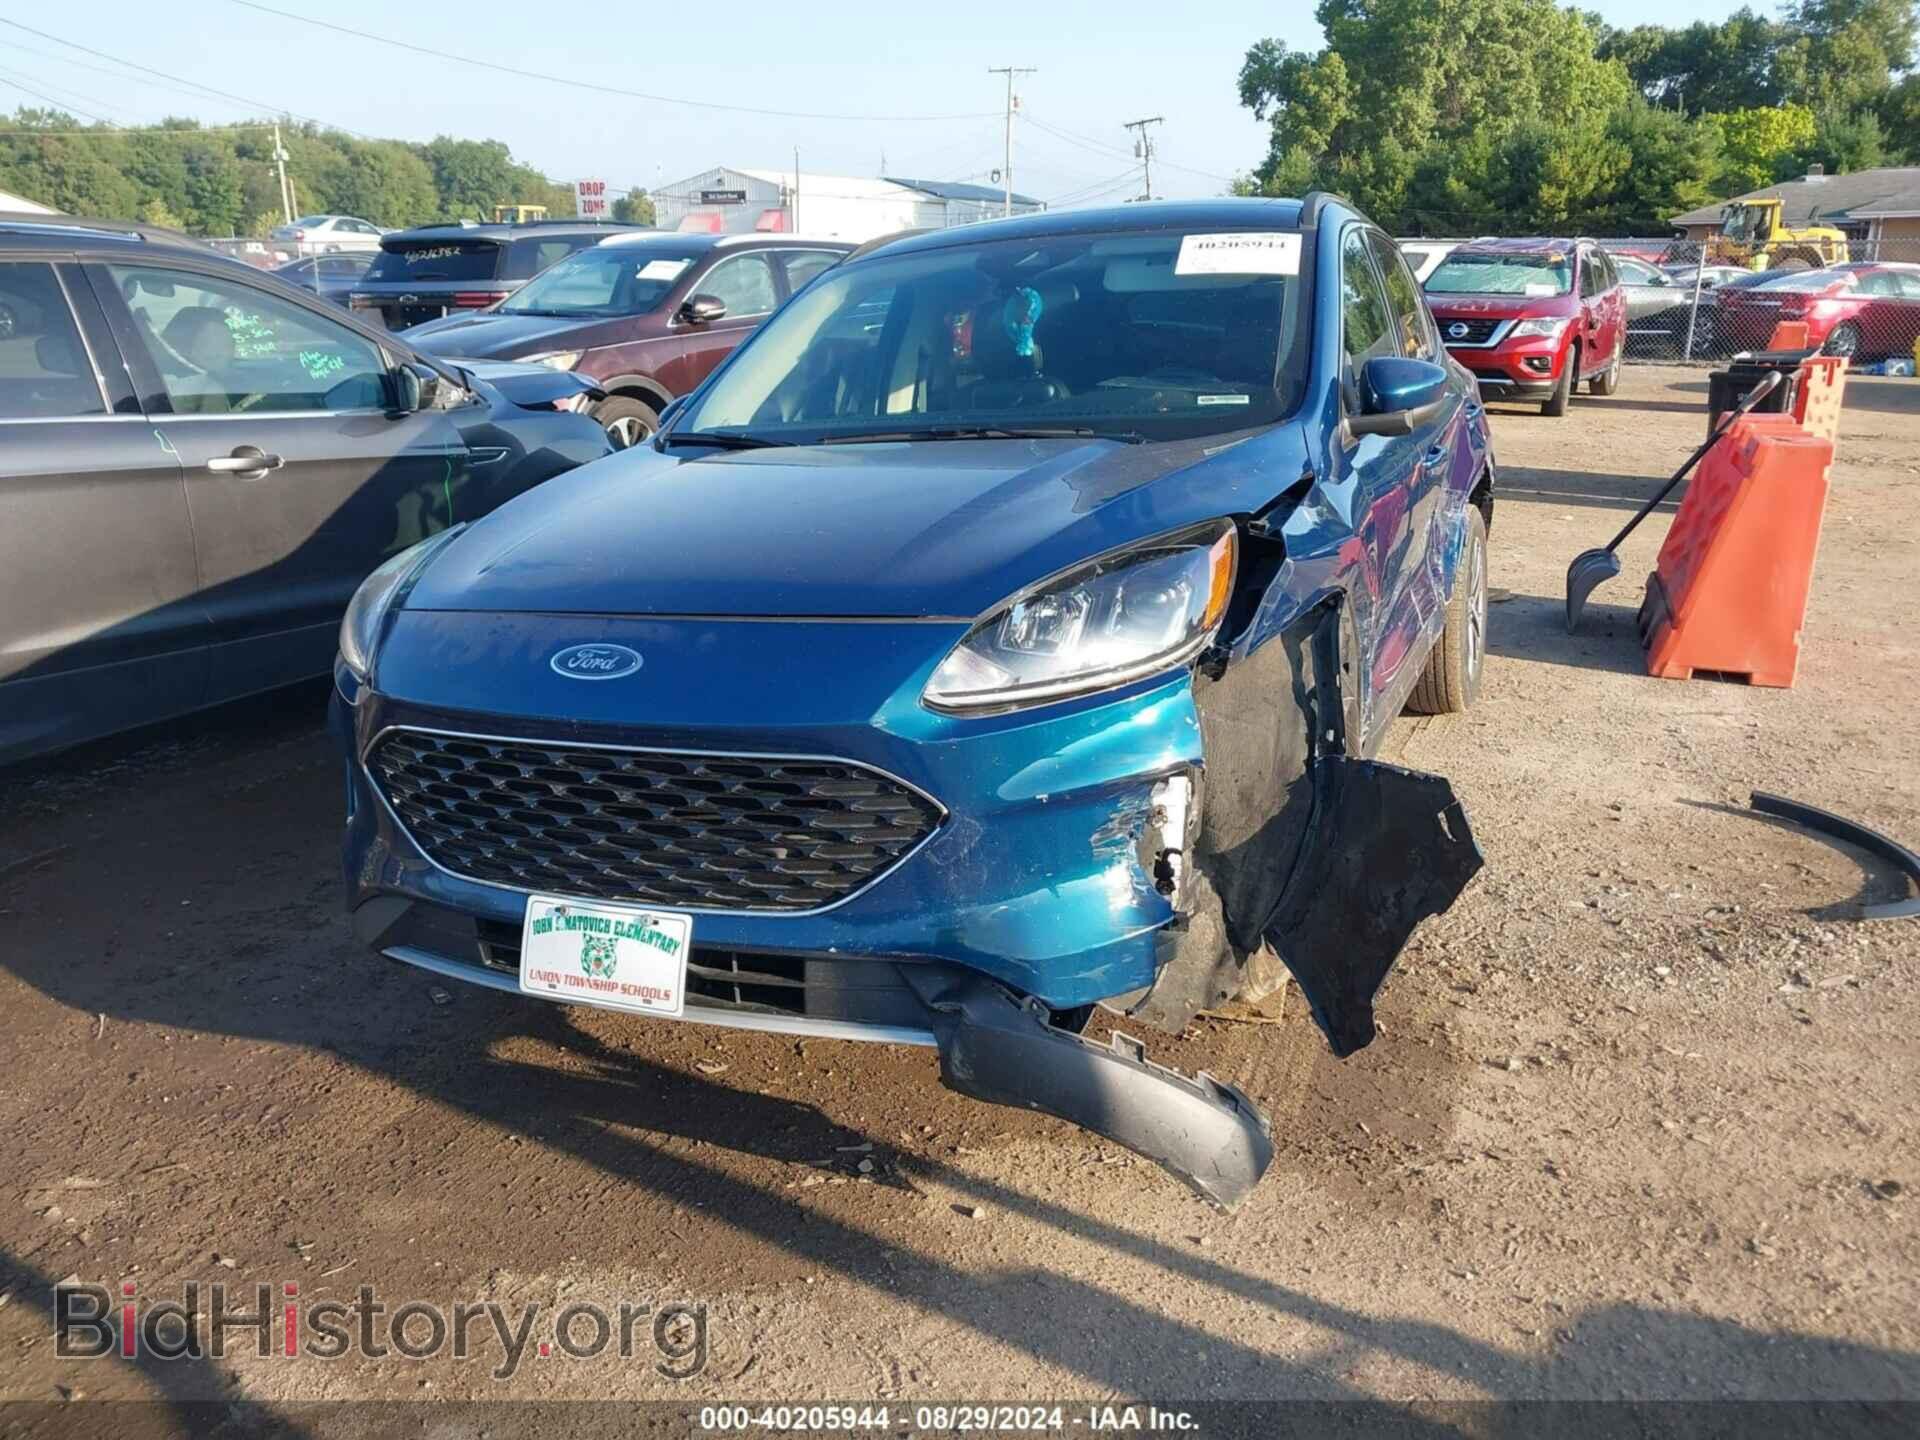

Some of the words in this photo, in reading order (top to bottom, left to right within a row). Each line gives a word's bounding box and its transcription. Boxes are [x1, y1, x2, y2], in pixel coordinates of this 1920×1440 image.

[579, 182, 605, 196] DROP
[1194, 239, 1286, 250] 40205944
[567, 648, 621, 671] Ford
[532, 917, 553, 936] JOHN
[614, 920, 681, 956] ELEMENTARY
[529, 968, 562, 985] UNION
[563, 974, 619, 993] TOWNSHIP
[620, 983, 672, 1001] SCHOOLS
